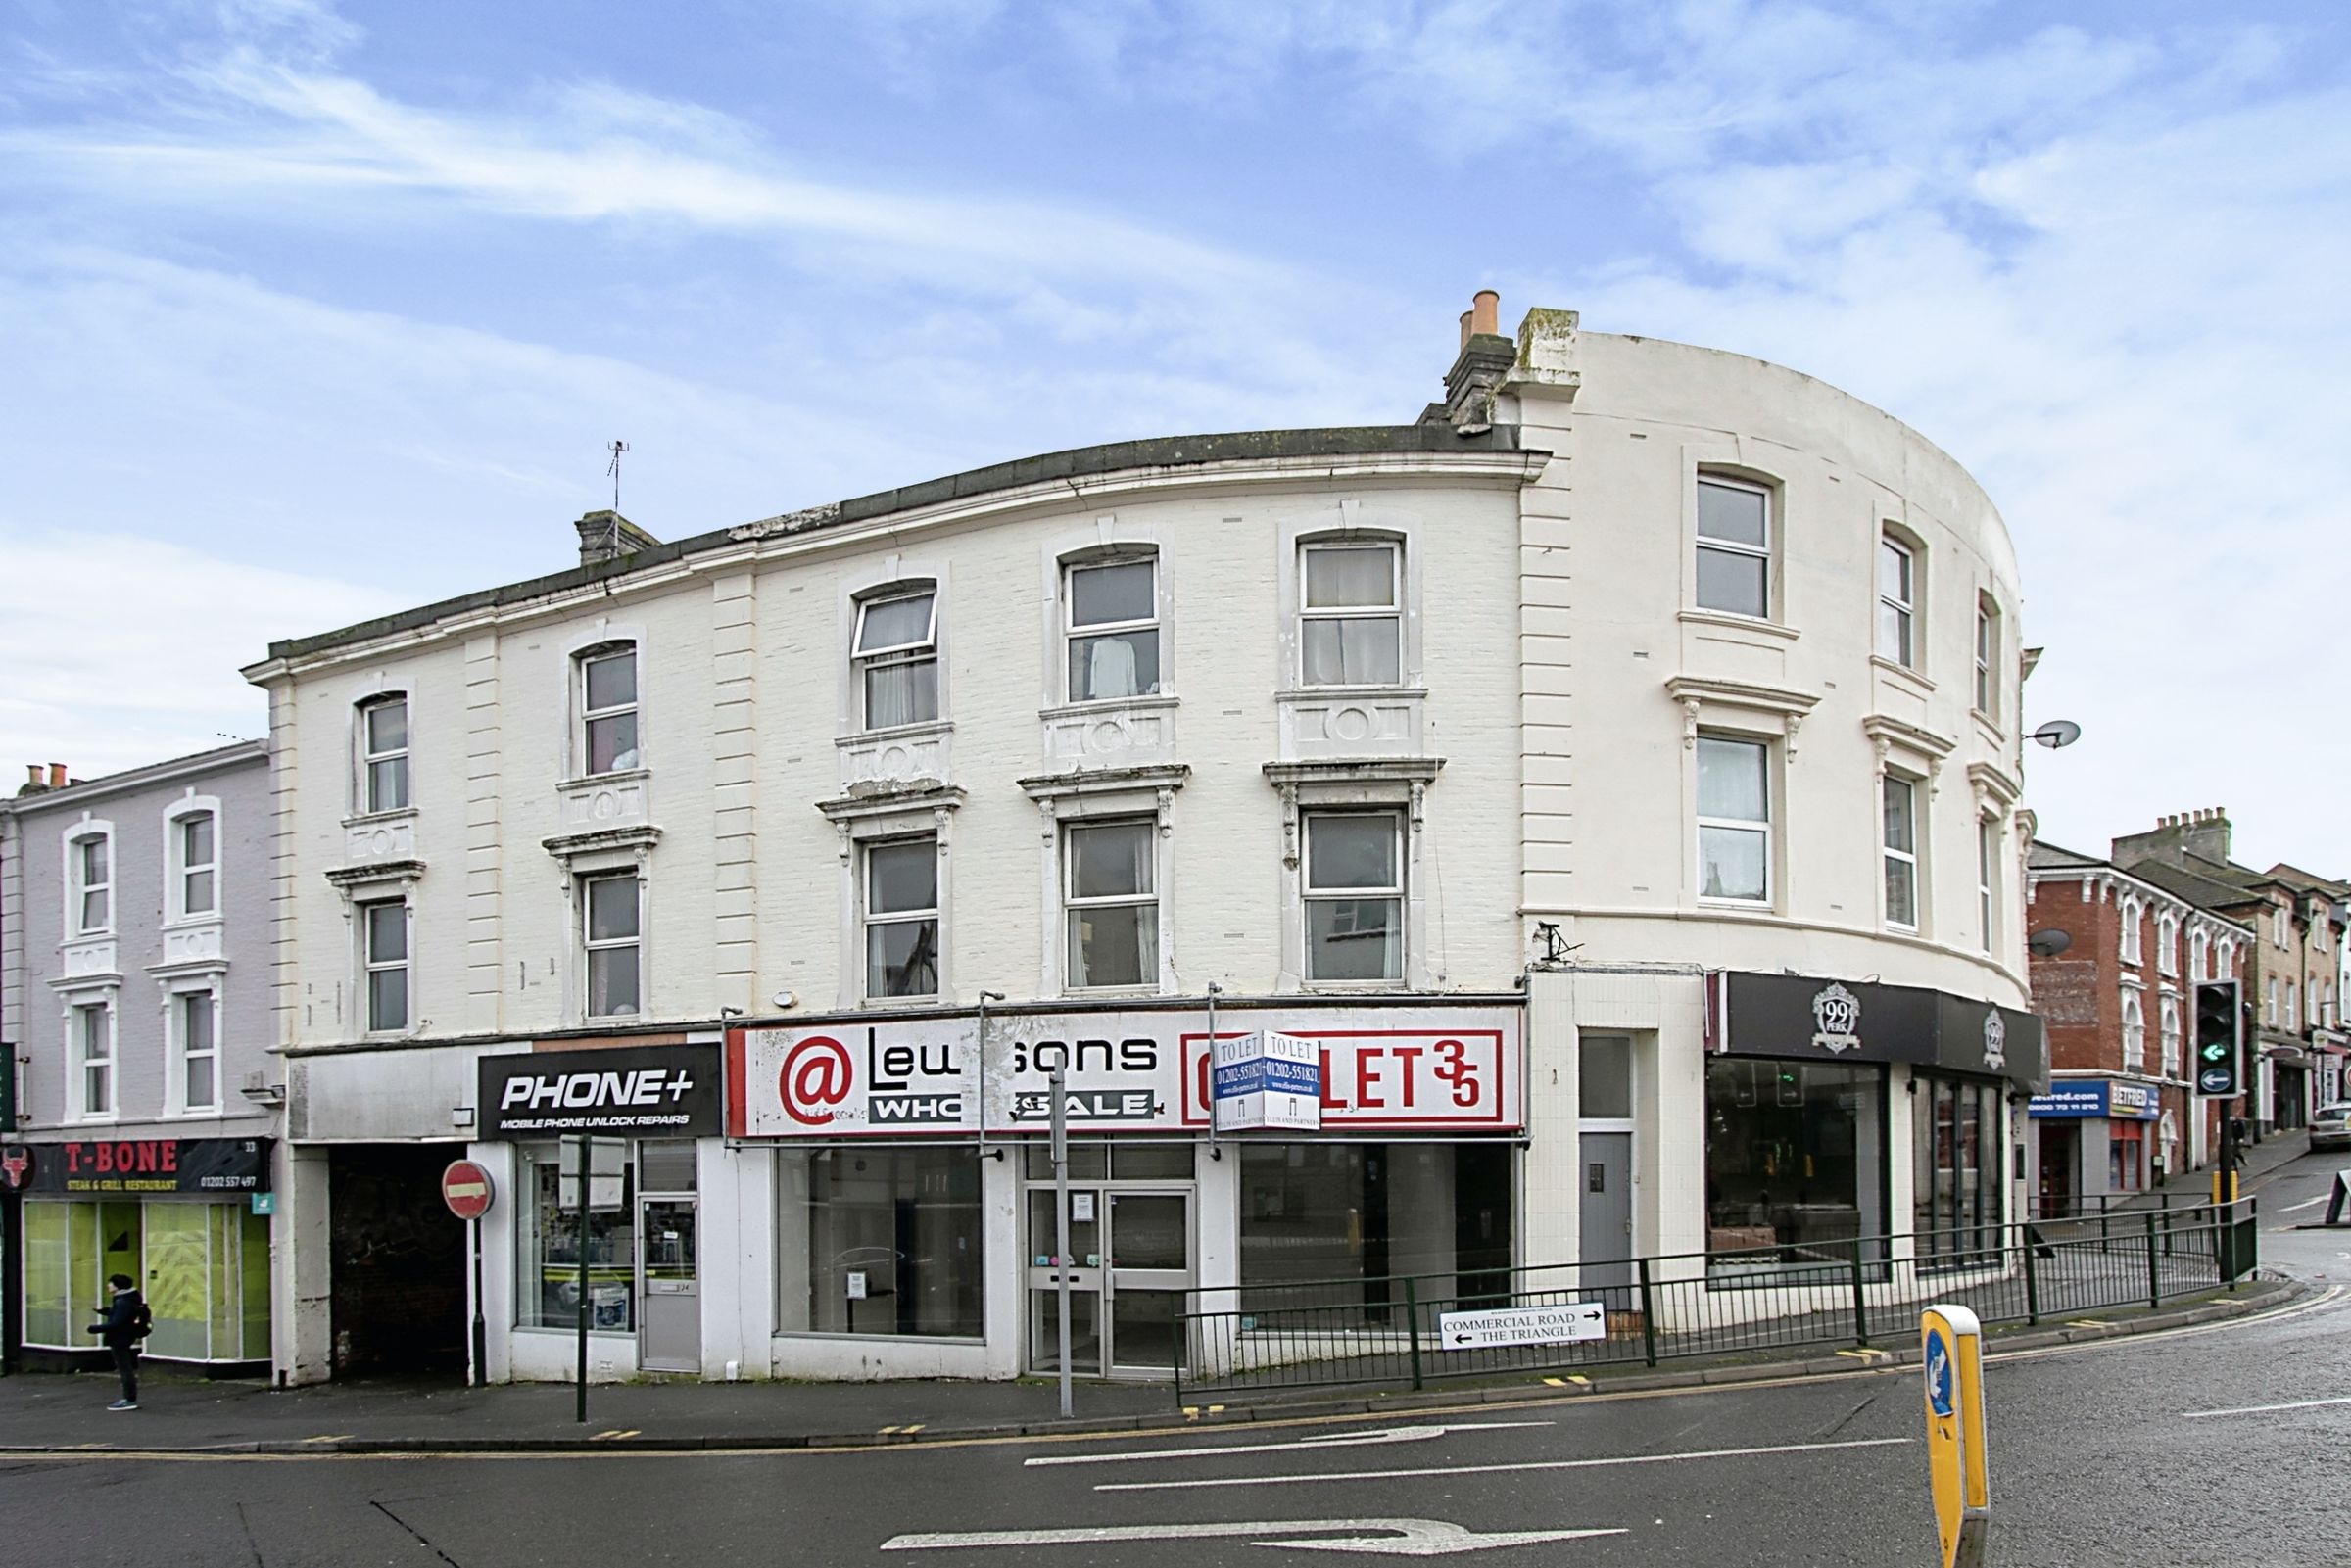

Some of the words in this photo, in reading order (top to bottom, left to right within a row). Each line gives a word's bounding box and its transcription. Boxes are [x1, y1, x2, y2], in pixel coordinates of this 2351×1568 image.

[1825, 1001, 1848, 1023] 99
[1221, 1044, 1236, 1062] TO
[1238, 1037, 1258, 1058] LET
[1271, 1036, 1286, 1055] TO
[1289, 1040, 1312, 1059] LET
[1266, 1061, 1318, 1082] 01202-551821
[500, 1069, 694, 1110] PHONE+
[2112, 1086, 2148, 1107] BETFRED
[500, 1118, 544, 1129] MOBILE
[544, 1117, 585, 1128] PHONE
[586, 1116, 636, 1127] UNLOCK
[636, 1115, 690, 1125] REPAIRS
[65, 1141, 177, 1172] T-BONE
[245, 1140, 256, 1153] 33
[67, 1180, 91, 1191] STEAK
[101, 1180, 123, 1191] GRILL
[124, 1179, 178, 1191] RESTAURANT
[200, 1176, 224, 1187] 01202
[225, 1176, 240, 1187] 557
[1443, 1316, 1535, 1333] COMMERCIAL
[1537, 1313, 1576, 1325] ROAD
[1480, 1331, 1509, 1343] THE
[1510, 1325, 1577, 1340] TRIANGLE
